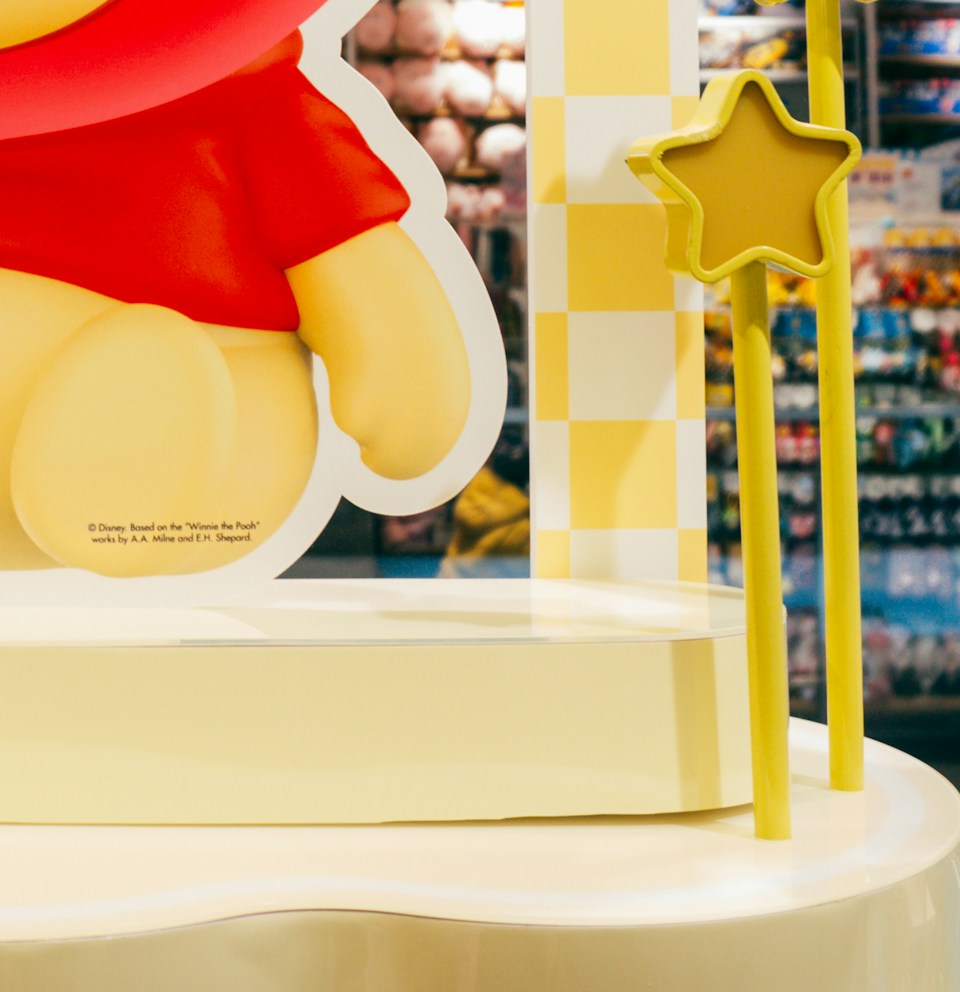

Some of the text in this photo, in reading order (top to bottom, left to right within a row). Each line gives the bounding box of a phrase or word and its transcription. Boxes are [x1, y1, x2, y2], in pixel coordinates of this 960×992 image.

[130, 522, 155, 532] Based
[156, 524, 168, 532] on
[170, 521, 183, 531] the
[221, 520, 234, 530] the
[91, 533, 116, 543] works
[118, 533, 128, 545] by
[152, 533, 176, 543] Milne
[178, 532, 194, 542] and
